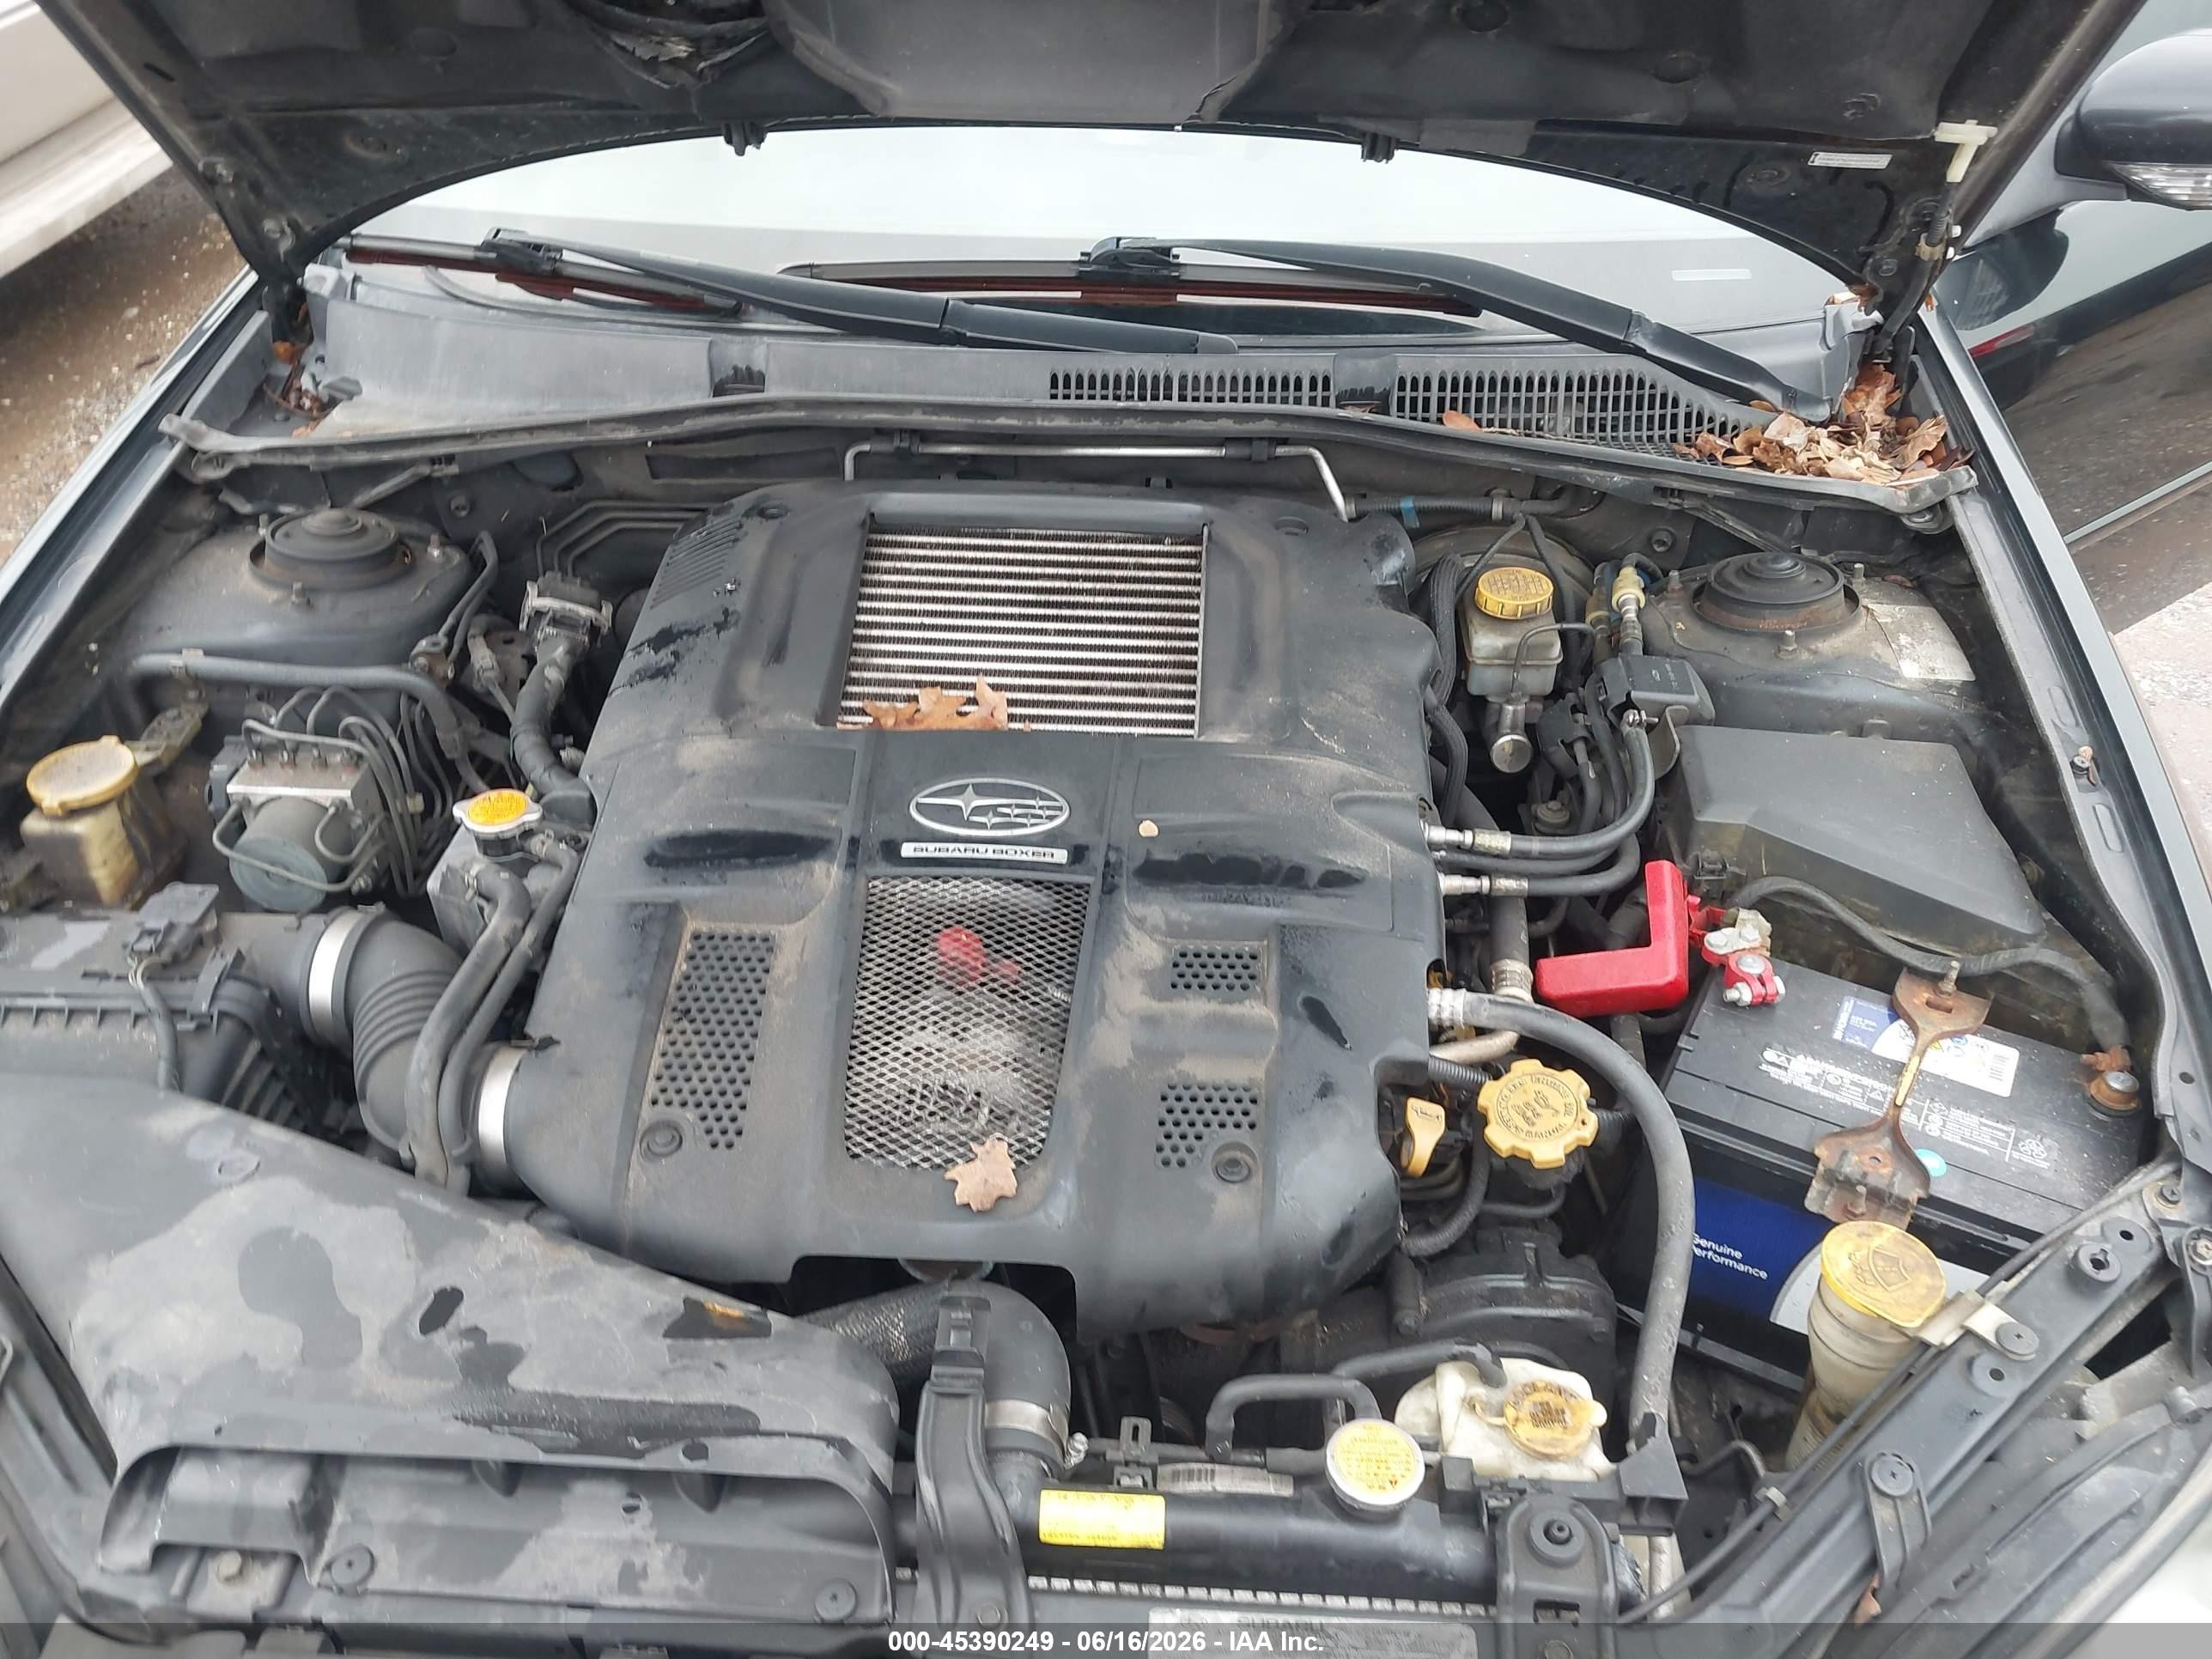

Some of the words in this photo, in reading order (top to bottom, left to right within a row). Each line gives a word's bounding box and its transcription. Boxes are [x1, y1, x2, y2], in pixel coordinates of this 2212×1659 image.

[913, 845, 988, 855] SUBARU
[992, 848, 1054, 859] BOXER
[1692, 1244, 1769, 1280] erformance
